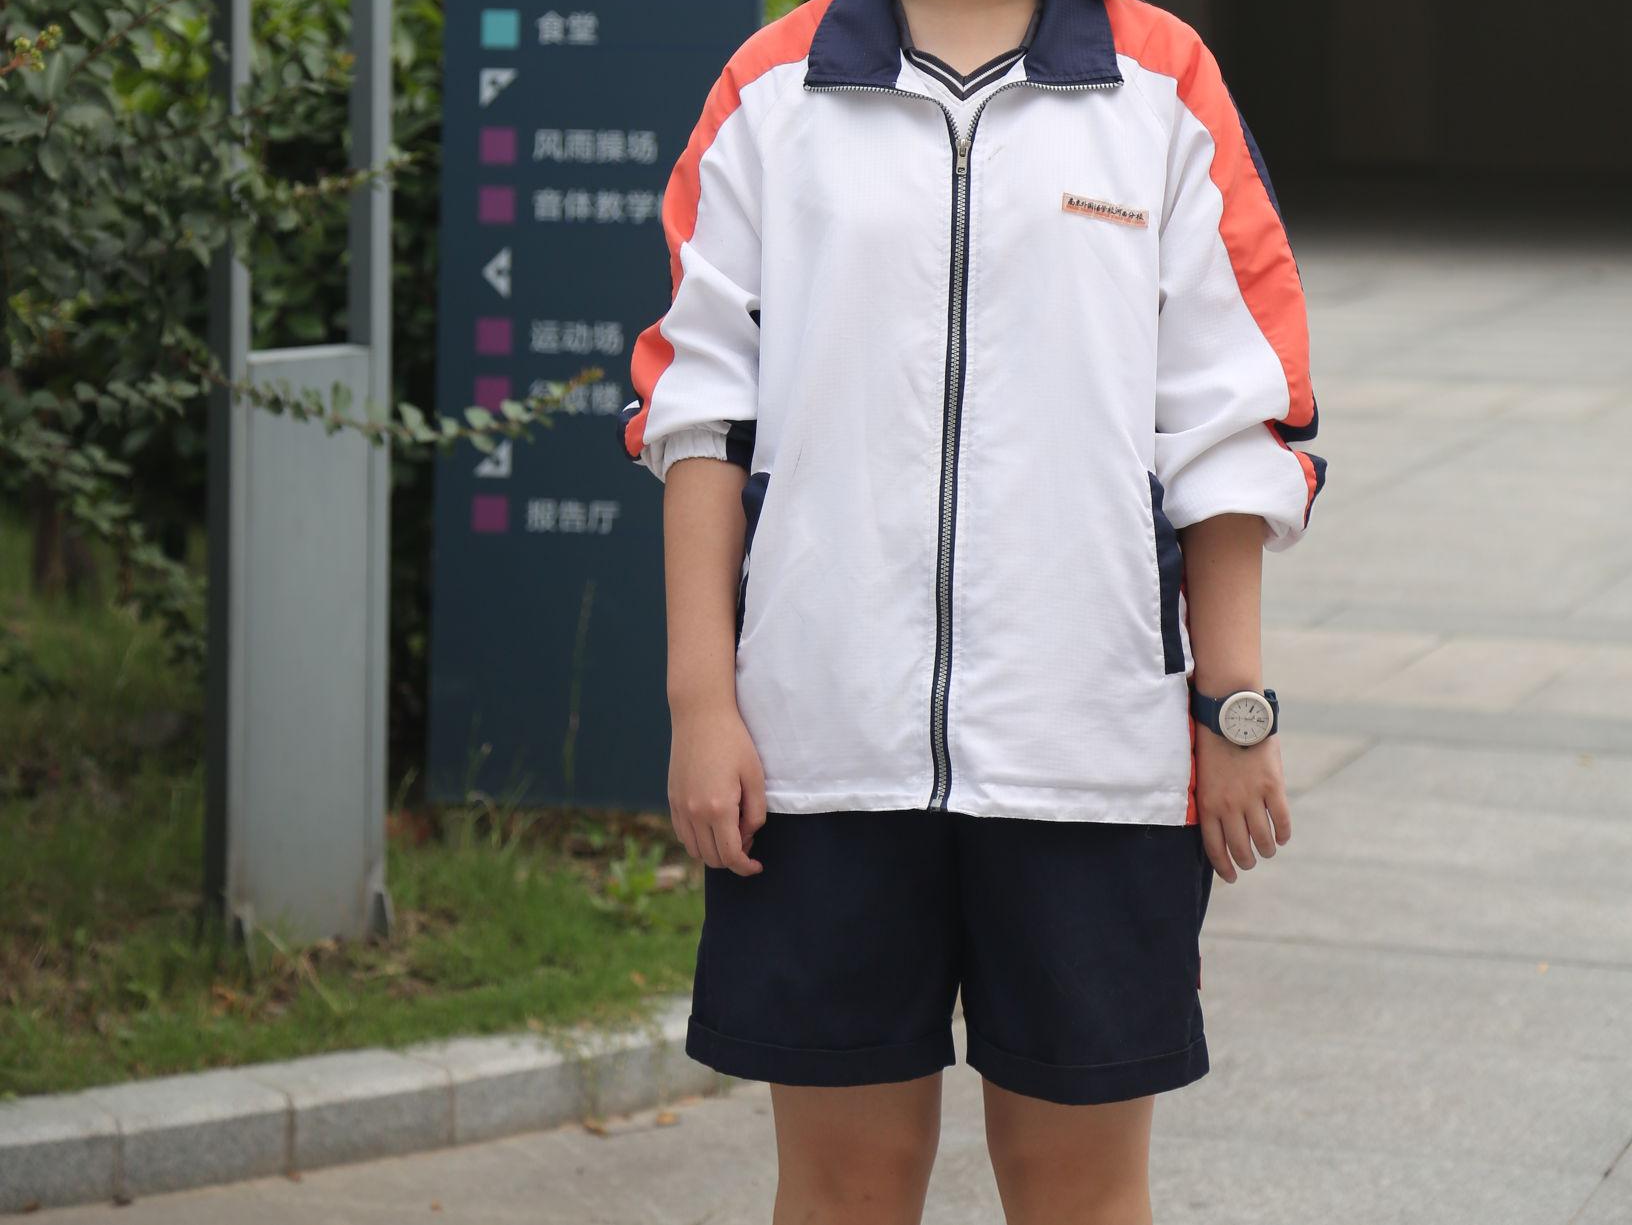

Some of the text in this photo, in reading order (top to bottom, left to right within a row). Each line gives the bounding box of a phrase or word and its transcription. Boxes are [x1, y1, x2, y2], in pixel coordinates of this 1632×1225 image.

[535, 10, 599, 45] 食堂
[532, 128, 658, 164] 风雨操场
[532, 188, 662, 225] 音体教学
[530, 320, 624, 356] 运动场
[525, 498, 621, 534] 报告厅
